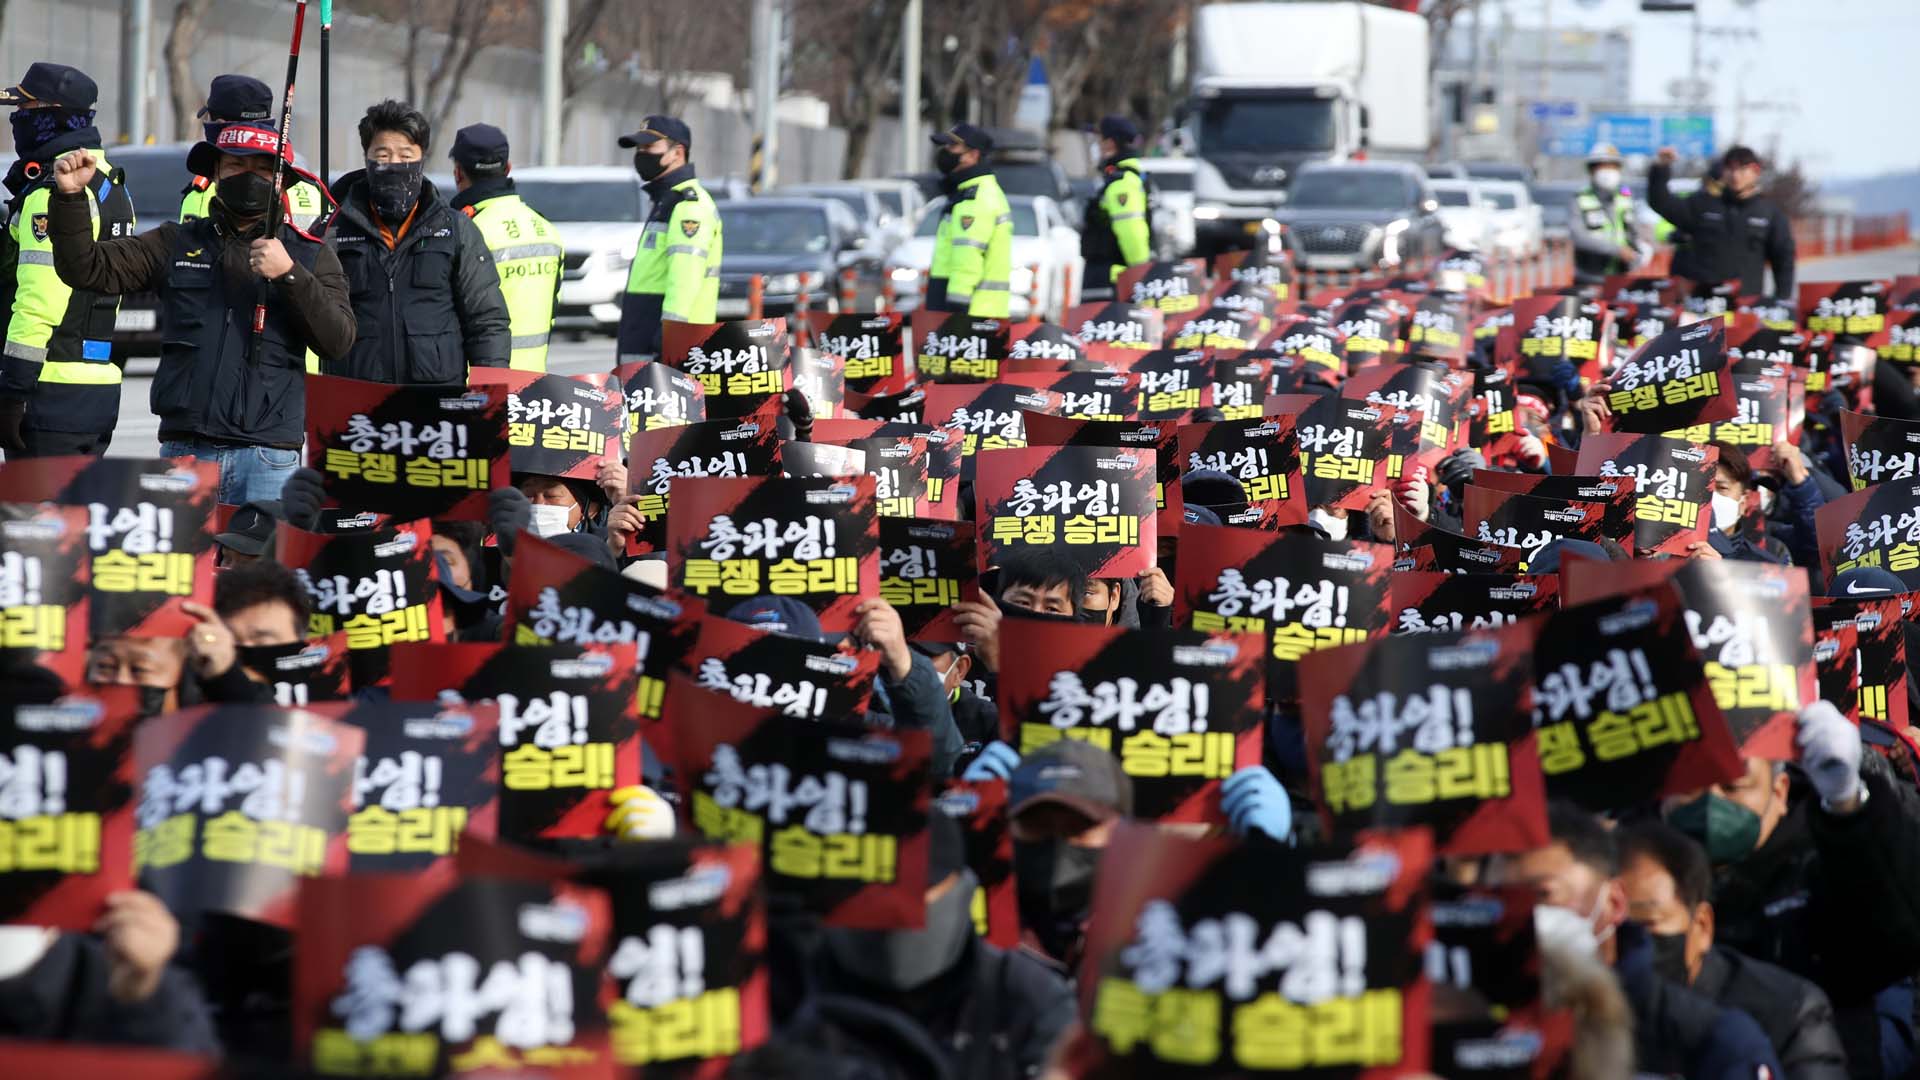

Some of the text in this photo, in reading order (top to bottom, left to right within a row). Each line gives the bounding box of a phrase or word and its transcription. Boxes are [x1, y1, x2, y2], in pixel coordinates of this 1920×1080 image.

[280, 113, 290, 145] CARBON
[294, 185, 311, 207] 찰
[684, 345, 768, 375] 총파업!
[925, 331, 987, 359] 총파업!
[690, 374, 721, 395] 쟁
[727, 370, 785, 396] 승리!
[844, 356, 892, 379] 승리!
[950, 358, 998, 379] 승리!
[1617, 348, 1701, 392] 총파업!
[623, 387, 687, 420] 파업!
[1149, 388, 1200, 411] 승리!
[1608, 371, 1720, 414] 투쟁 승리!
[341, 414, 467, 460] 총파업!
[509, 423, 605, 455] 쟁 승리!
[1297, 424, 1364, 458] 파업!
[1715, 422, 1773, 445] 승리!
[326, 448, 489, 490] 투쟁 승리!
[1314, 453, 1374, 485] 승리!
[876, 496, 916, 519] 리!
[1007, 479, 1120, 517] 총파업!
[1635, 495, 1700, 530] 승리!
[700, 514, 837, 561] 총파업!
[993, 514, 1139, 546] 투쟁 승리!
[93, 548, 195, 596] 승리!
[683, 557, 858, 595] 투쟁 승리!
[880, 546, 937, 578] 업!
[1208, 568, 1350, 629] 총파업!
[0, 604, 66, 652] 리!
[343, 604, 429, 650] 승리!
[1040, 670, 1210, 736] 총파업!
[1326, 682, 1475, 765] 총파업!
[1121, 728, 1236, 779] 승리!
[1535, 691, 1700, 775] 쟁 승리!
[503, 742, 615, 791] 승리!
[1384, 742, 1511, 805] 승리!
[703, 743, 866, 836] 총파업!
[0, 811, 101, 874] 리!
[770, 825, 895, 883] 승리!
[1121, 898, 1368, 1008] 총파업!
[330, 945, 575, 1050] 총파업!
[1232, 986, 1402, 1069] 승리!
